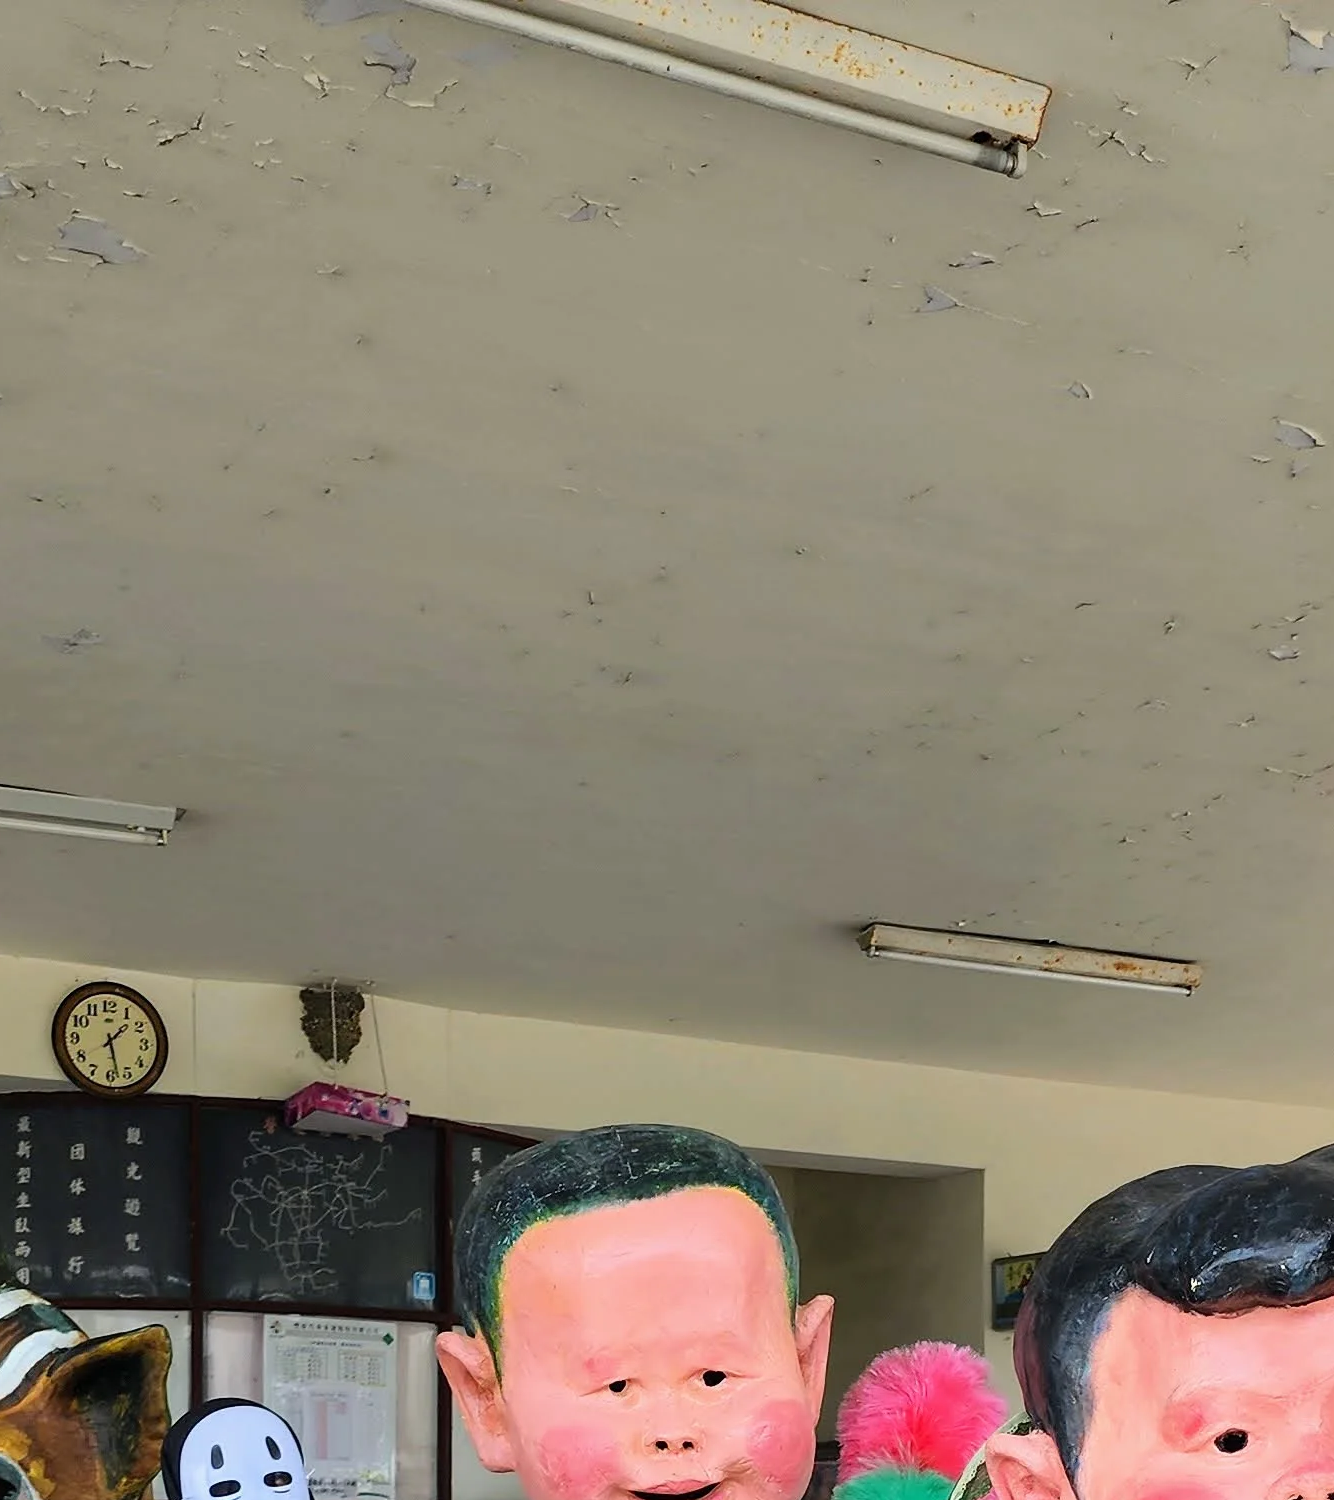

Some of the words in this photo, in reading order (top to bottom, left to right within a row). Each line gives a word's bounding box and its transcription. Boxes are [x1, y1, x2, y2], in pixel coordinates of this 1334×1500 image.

[87, 1003, 98, 1016] 11
[103, 1000, 117, 1013] 12
[123, 1007, 131, 1020] 1
[73, 1015, 89, 1028] 10
[135, 1021, 144, 1033] 2
[70, 1032, 80, 1044] 9
[139, 1038, 149, 1051] 3
[76, 1049, 86, 1063] 8
[134, 1055, 144, 1068] 4
[88, 1063, 98, 1076] 7
[106, 1069, 115, 1082] 6
[123, 1067, 132, 1080] 5
